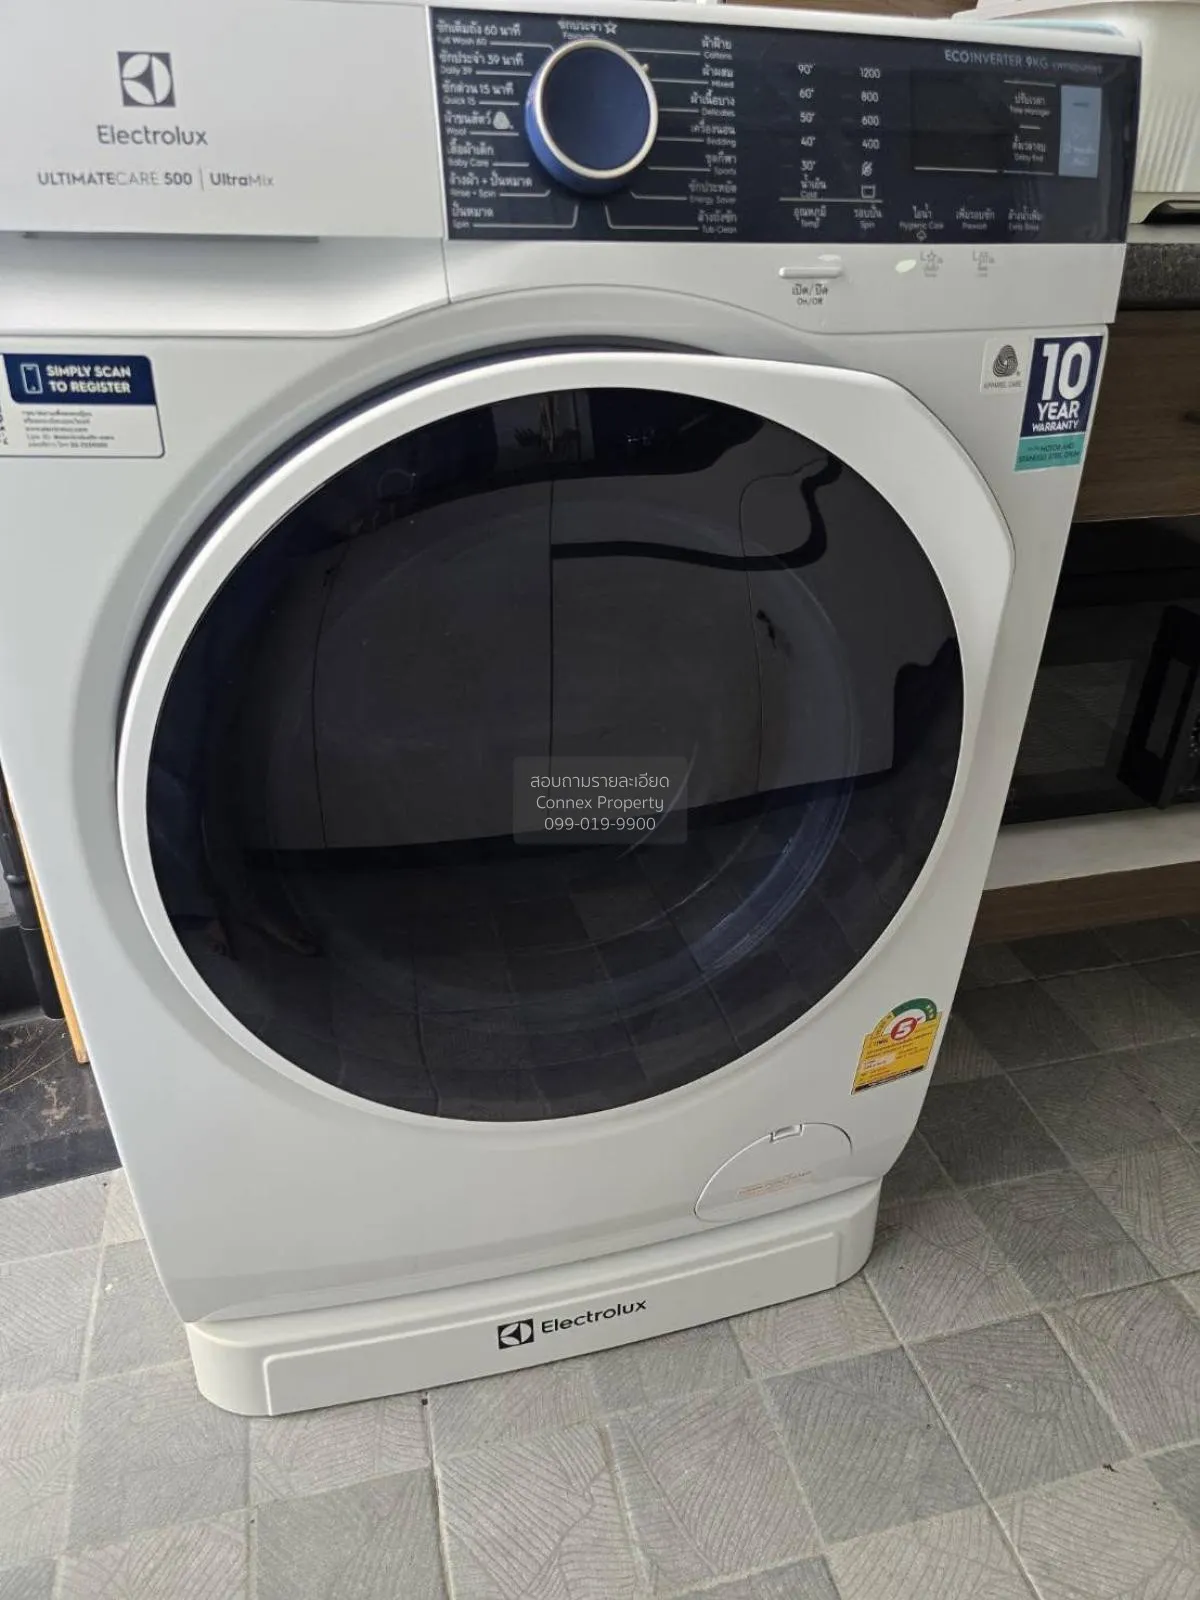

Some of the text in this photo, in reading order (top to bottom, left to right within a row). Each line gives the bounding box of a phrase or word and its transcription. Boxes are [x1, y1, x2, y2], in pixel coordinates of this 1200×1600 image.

[484, 24, 498, 36] 60
[499, 23, 521, 37] นาที
[487, 54, 499, 66] 39
[501, 53, 525, 67] นาที
[944, 49, 1022, 67] ECOINVERTER
[1025, 56, 1048, 70] 9KG
[859, 67, 881, 80] 1200
[442, 79, 515, 96] ซักด่วน 15 นาที
[861, 90, 879, 103] 800
[861, 115, 880, 127] 600
[96, 124, 209, 147] Electrolux
[862, 138, 881, 150] 400
[37, 170, 275, 188] ULTIMATECARE 500 UltraMix
[490, 169, 533, 188] ปั่นหมาด
[451, 201, 495, 218] ปั่นหมาด
[46, 364, 131, 379] SIMPLY SCAN
[1041, 341, 1092, 401] 10
[49, 380, 131, 395] TO REGISTER
[1037, 400, 1081, 421] YEAR
[1031, 420, 1079, 433] WARRANTY
[541, 1300, 647, 1334] Electrolux
